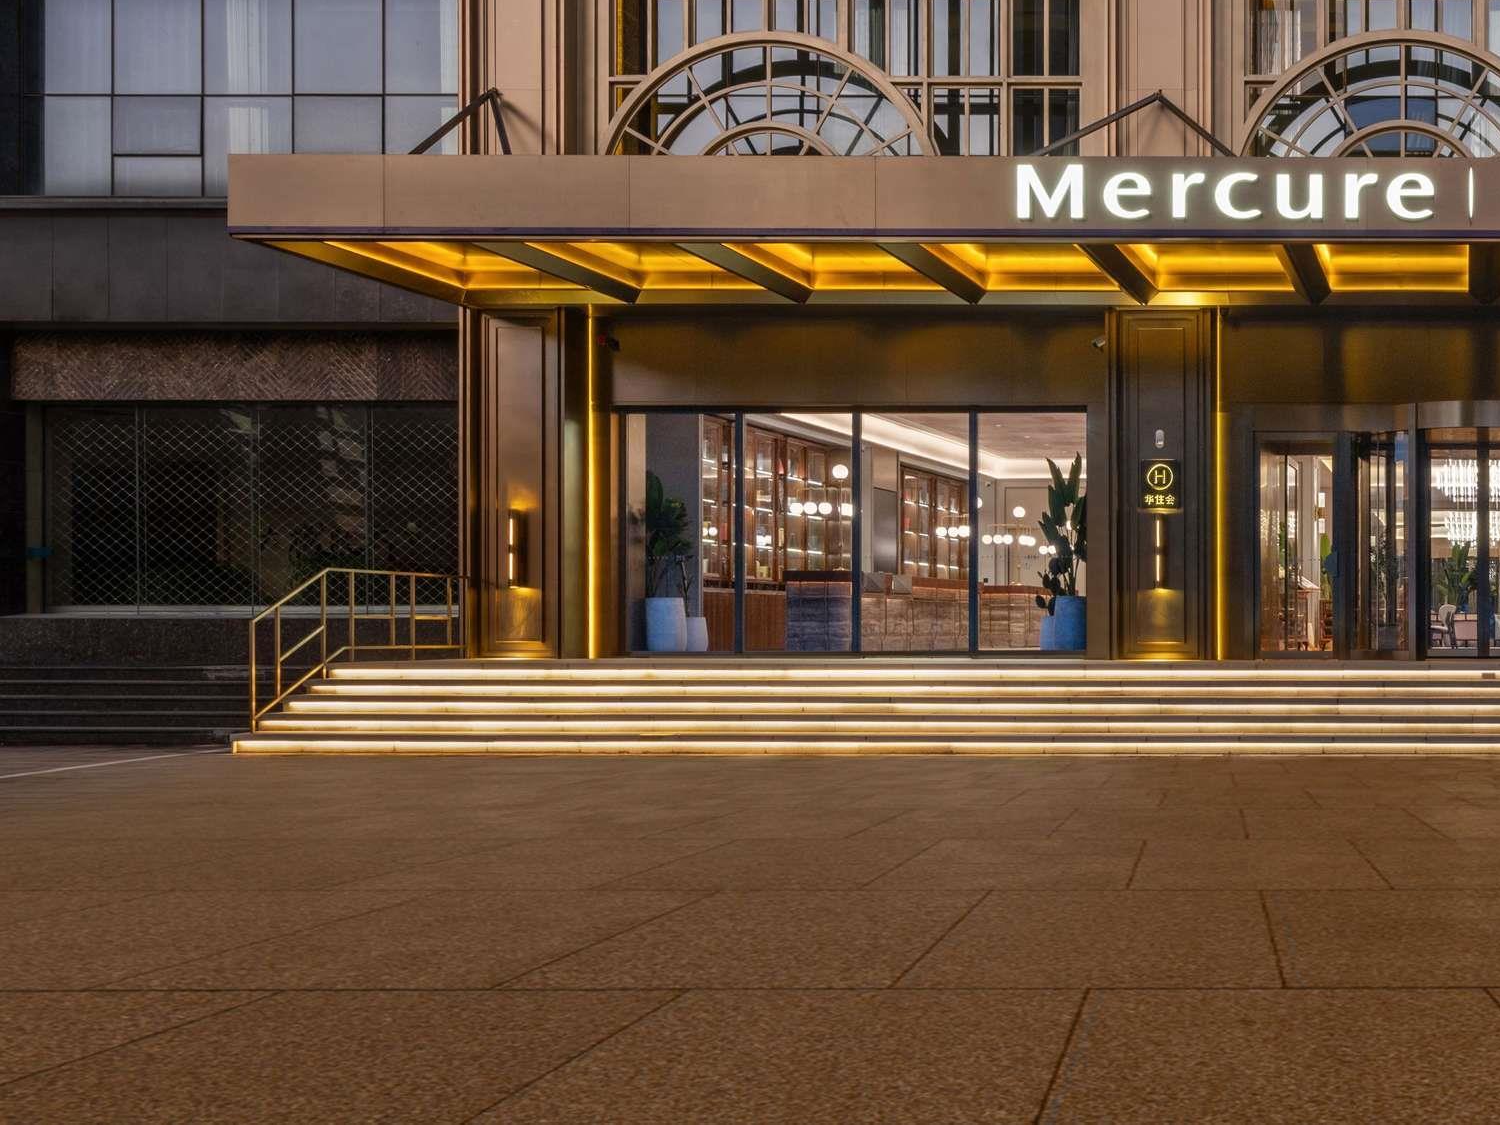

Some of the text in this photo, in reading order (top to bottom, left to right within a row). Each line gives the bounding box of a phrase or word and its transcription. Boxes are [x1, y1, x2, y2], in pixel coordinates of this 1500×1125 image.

[1016, 164, 1435, 219] Mercure
[1144, 494, 1176, 506] 华住会
